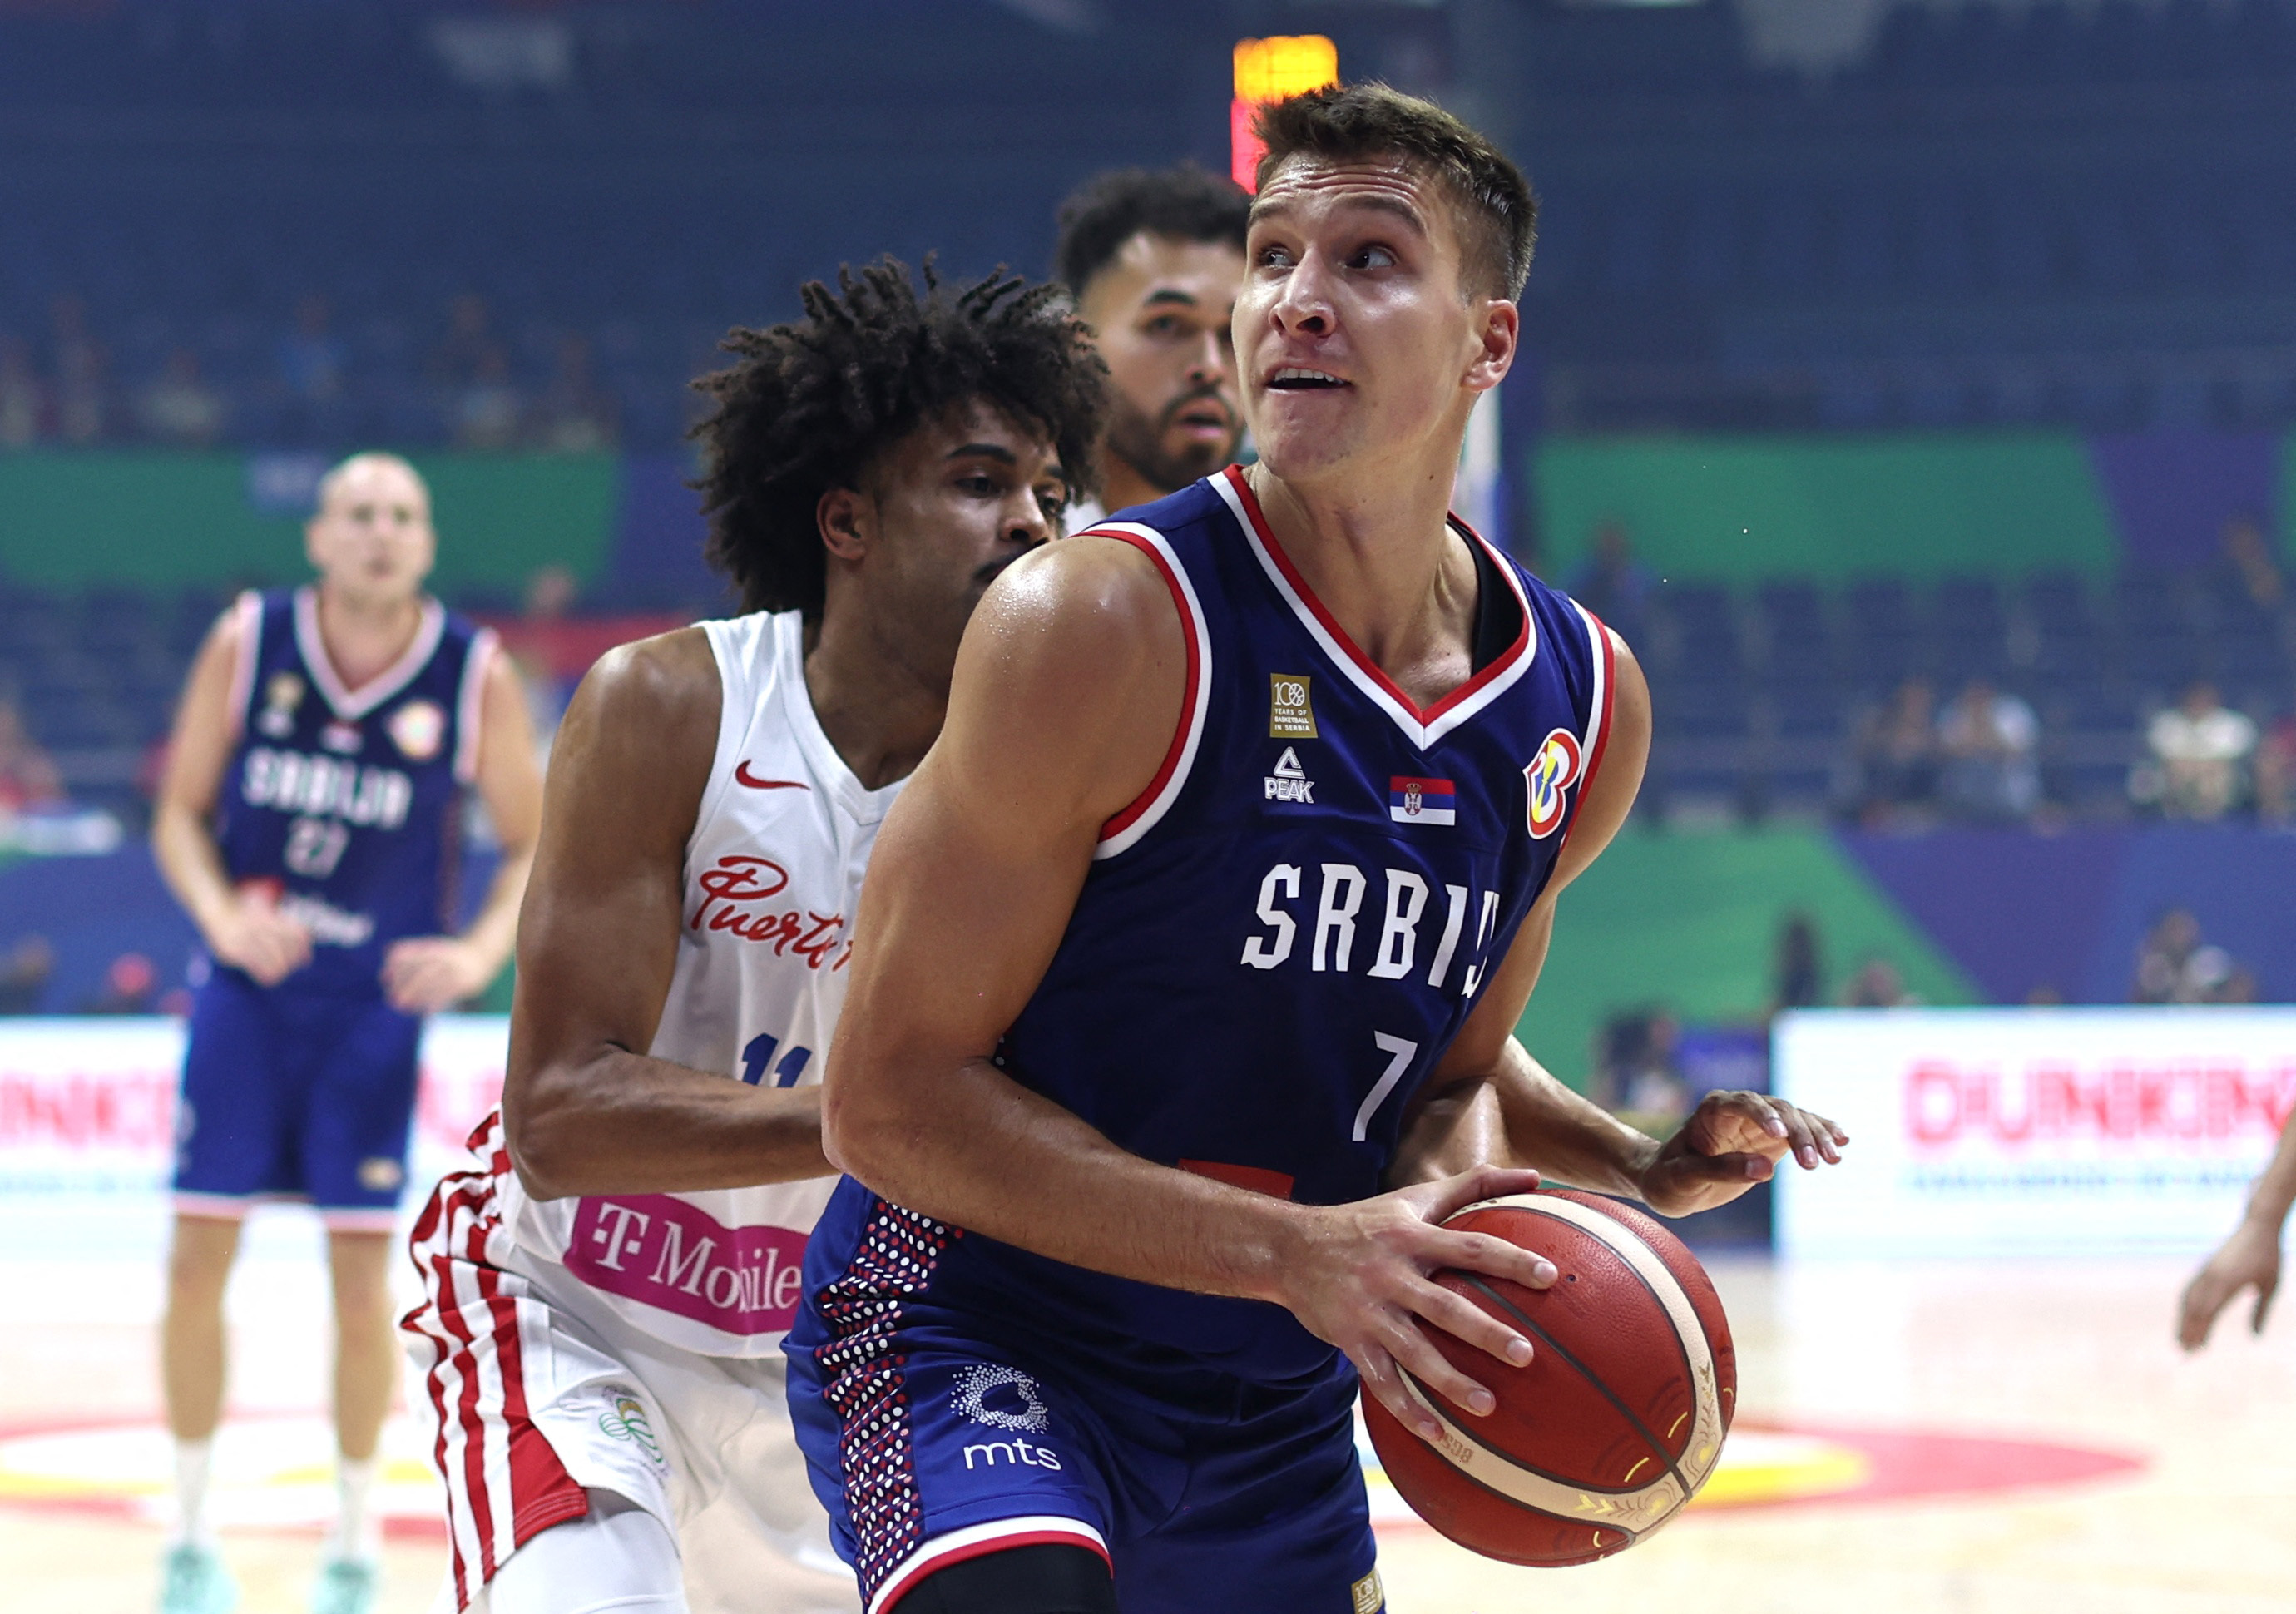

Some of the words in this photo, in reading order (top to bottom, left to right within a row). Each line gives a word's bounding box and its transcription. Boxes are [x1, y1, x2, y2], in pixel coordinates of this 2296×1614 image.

[1274, 715, 1310, 724] BASKETBALL
[1264, 776, 1315, 804] PEAK
[741, 1032, 813, 1087] 11
[1352, 1030, 1418, 1142] 7
[963, 1438, 1061, 1470] mts
